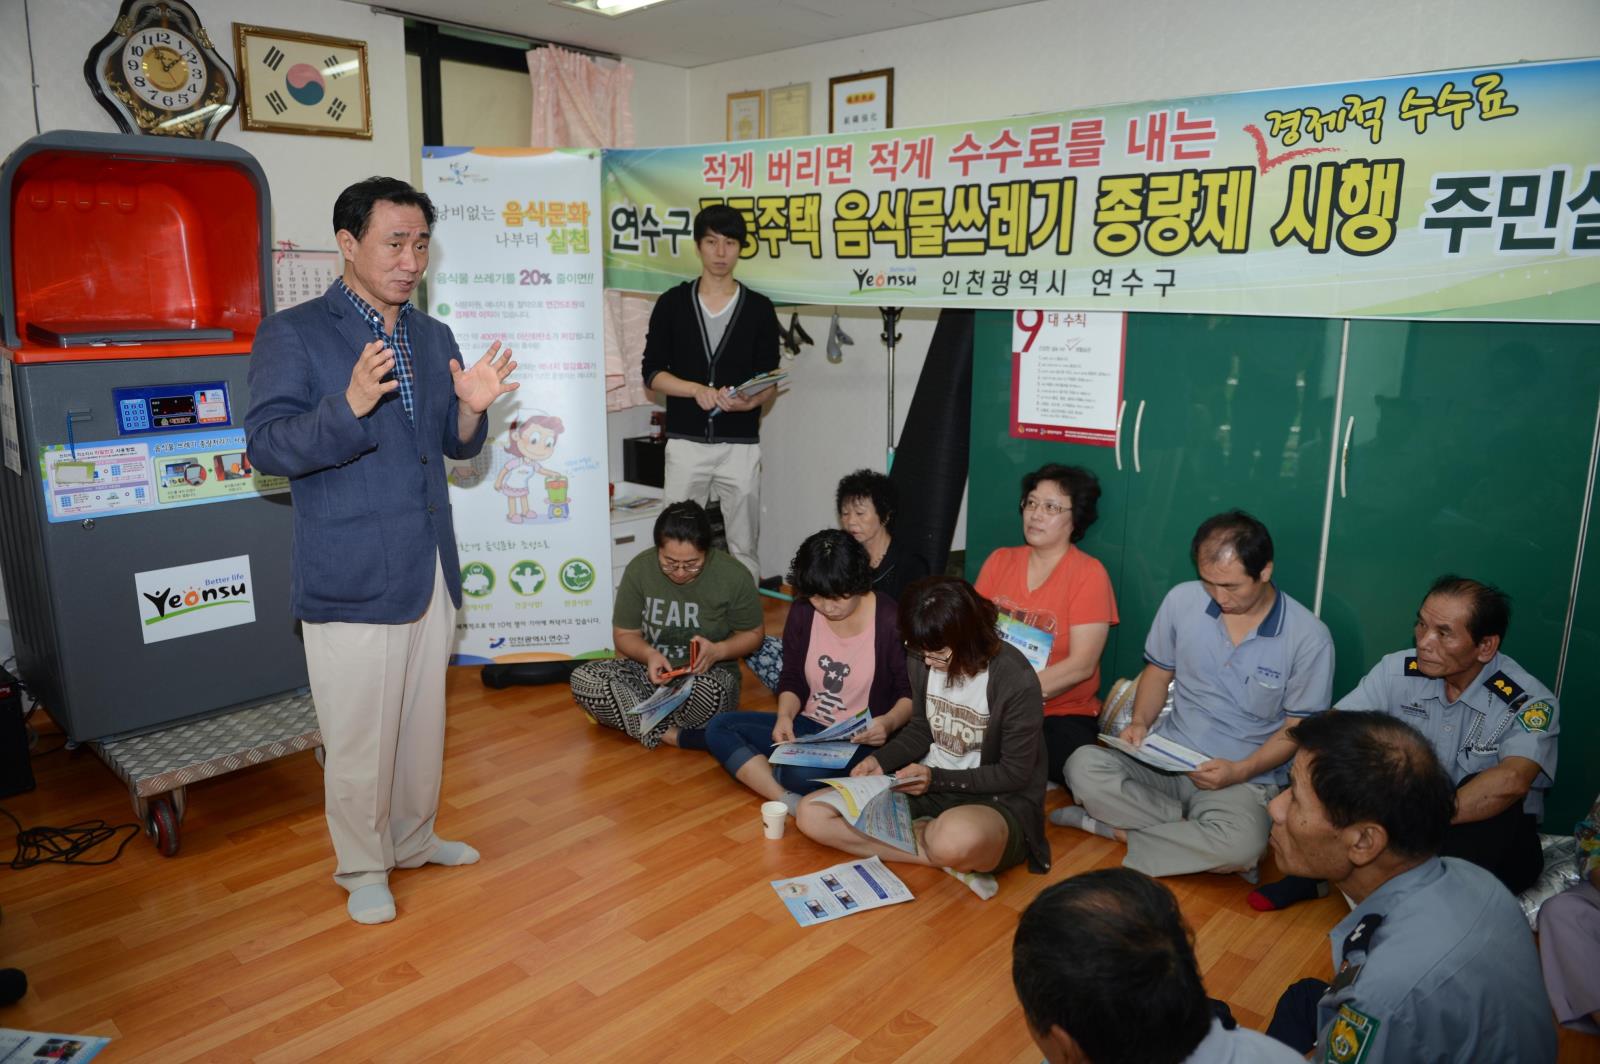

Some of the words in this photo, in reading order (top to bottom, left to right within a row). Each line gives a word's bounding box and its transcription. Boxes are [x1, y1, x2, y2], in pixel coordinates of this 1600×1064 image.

[142, 35, 153, 45] 11
[156, 33, 170, 44] 12
[178, 40, 182, 49] 1
[131, 46, 143, 57] 10
[186, 48, 198, 64] 2
[128, 60, 138, 70] 9
[192, 69, 202, 79] 3
[134, 76, 145, 87] 8
[148, 90, 158, 100] 7
[187, 84, 197, 93] 4
[163, 96, 173, 106] 6
[178, 93, 189, 103] 5
[1266, 94, 1386, 146] 경제적
[1400, 74, 1518, 133] 수수료
[703, 152, 753, 190] 적게
[768, 144, 853, 186] 버리면
[870, 138, 933, 183] 적게
[948, 119, 1105, 175] 수수료를
[1128, 109, 1216, 162] 내는
[502, 200, 591, 227] 음식문화
[611, 206, 692, 254] 연수구
[699, 193, 822, 259] 동주택
[834, 177, 1077, 259] 음식물쓰레기
[1095, 166, 1256, 257] 종량제
[1272, 158, 1404, 257] 시행
[496, 233, 539, 248] 나부터
[547, 228, 591, 254] 실천
[474, 272, 515, 284] 쓰레기를
[519, 269, 552, 286] 20%
[852, 268, 917, 291] Yeonsu
[942, 269, 1067, 297] 인천광역시
[1092, 269, 1176, 297] 연수구
[1048, 313, 1059, 327] 대
[1063, 313, 1086, 327] 수칙
[1016, 310, 1044, 353] 9
[205, 576, 229, 586] Better
[232, 573, 245, 581] life
[143, 582, 246, 617] Yeonsu
